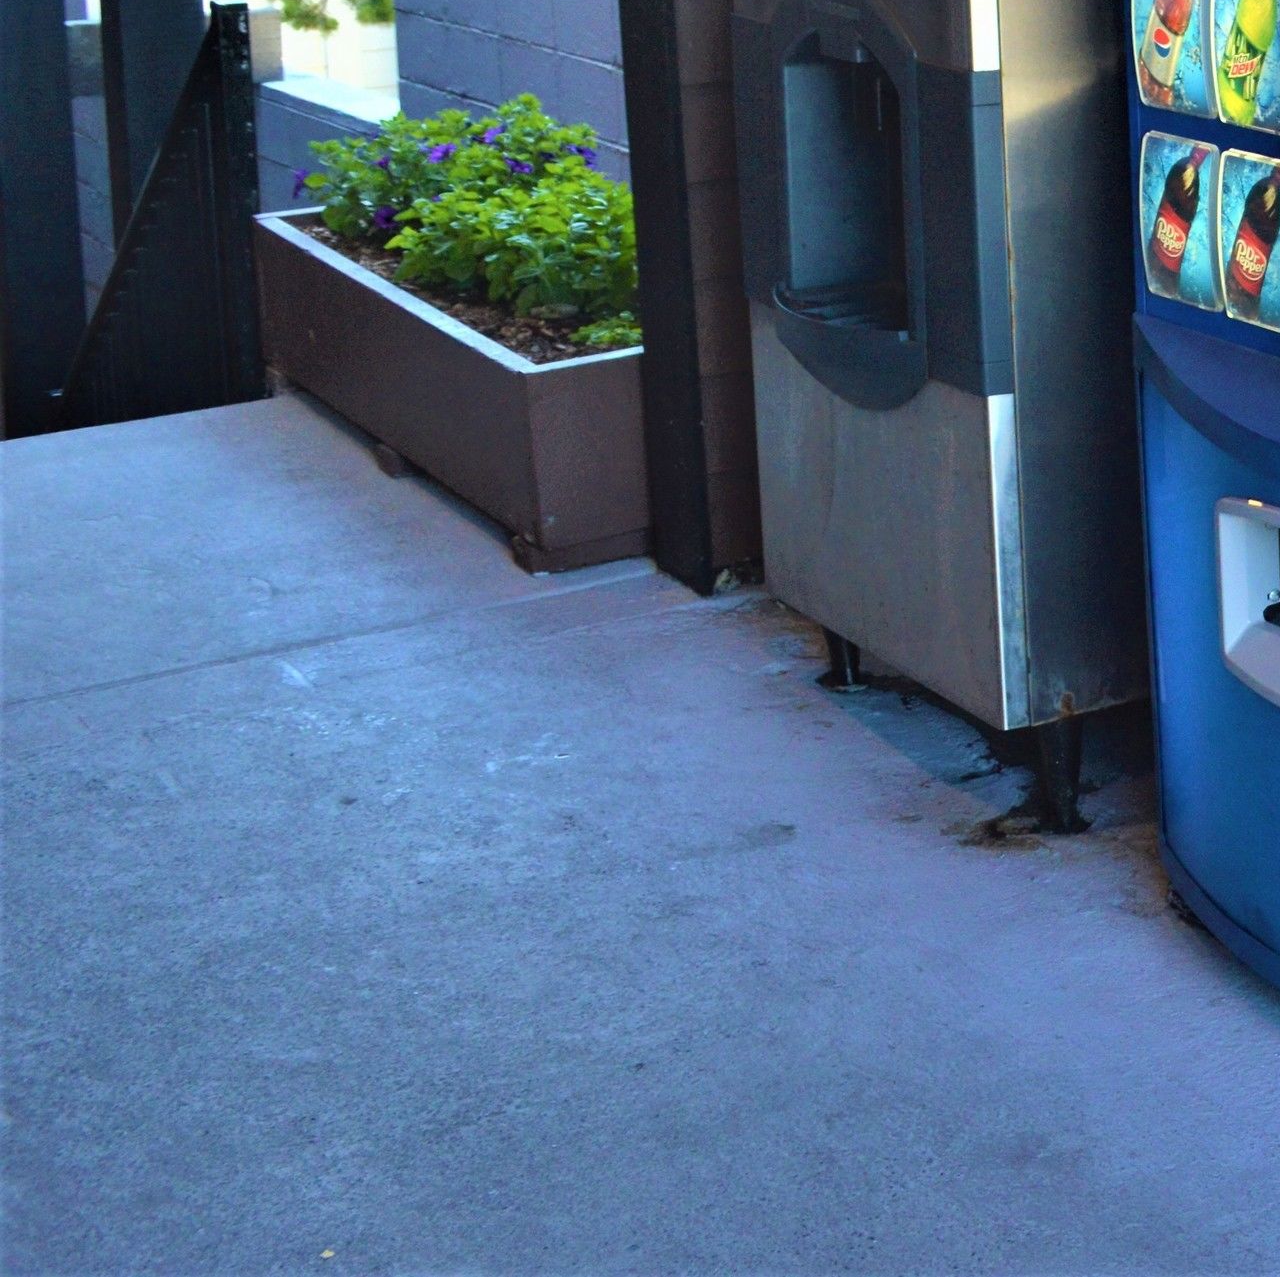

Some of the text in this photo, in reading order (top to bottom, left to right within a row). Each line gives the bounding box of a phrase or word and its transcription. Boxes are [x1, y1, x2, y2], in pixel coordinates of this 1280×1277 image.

[1156, 217, 1183, 253] Pepper
[1166, 224, 1180, 240] Dr
[1236, 239, 1265, 273] Pepper
[1246, 248, 1260, 264] Dr
